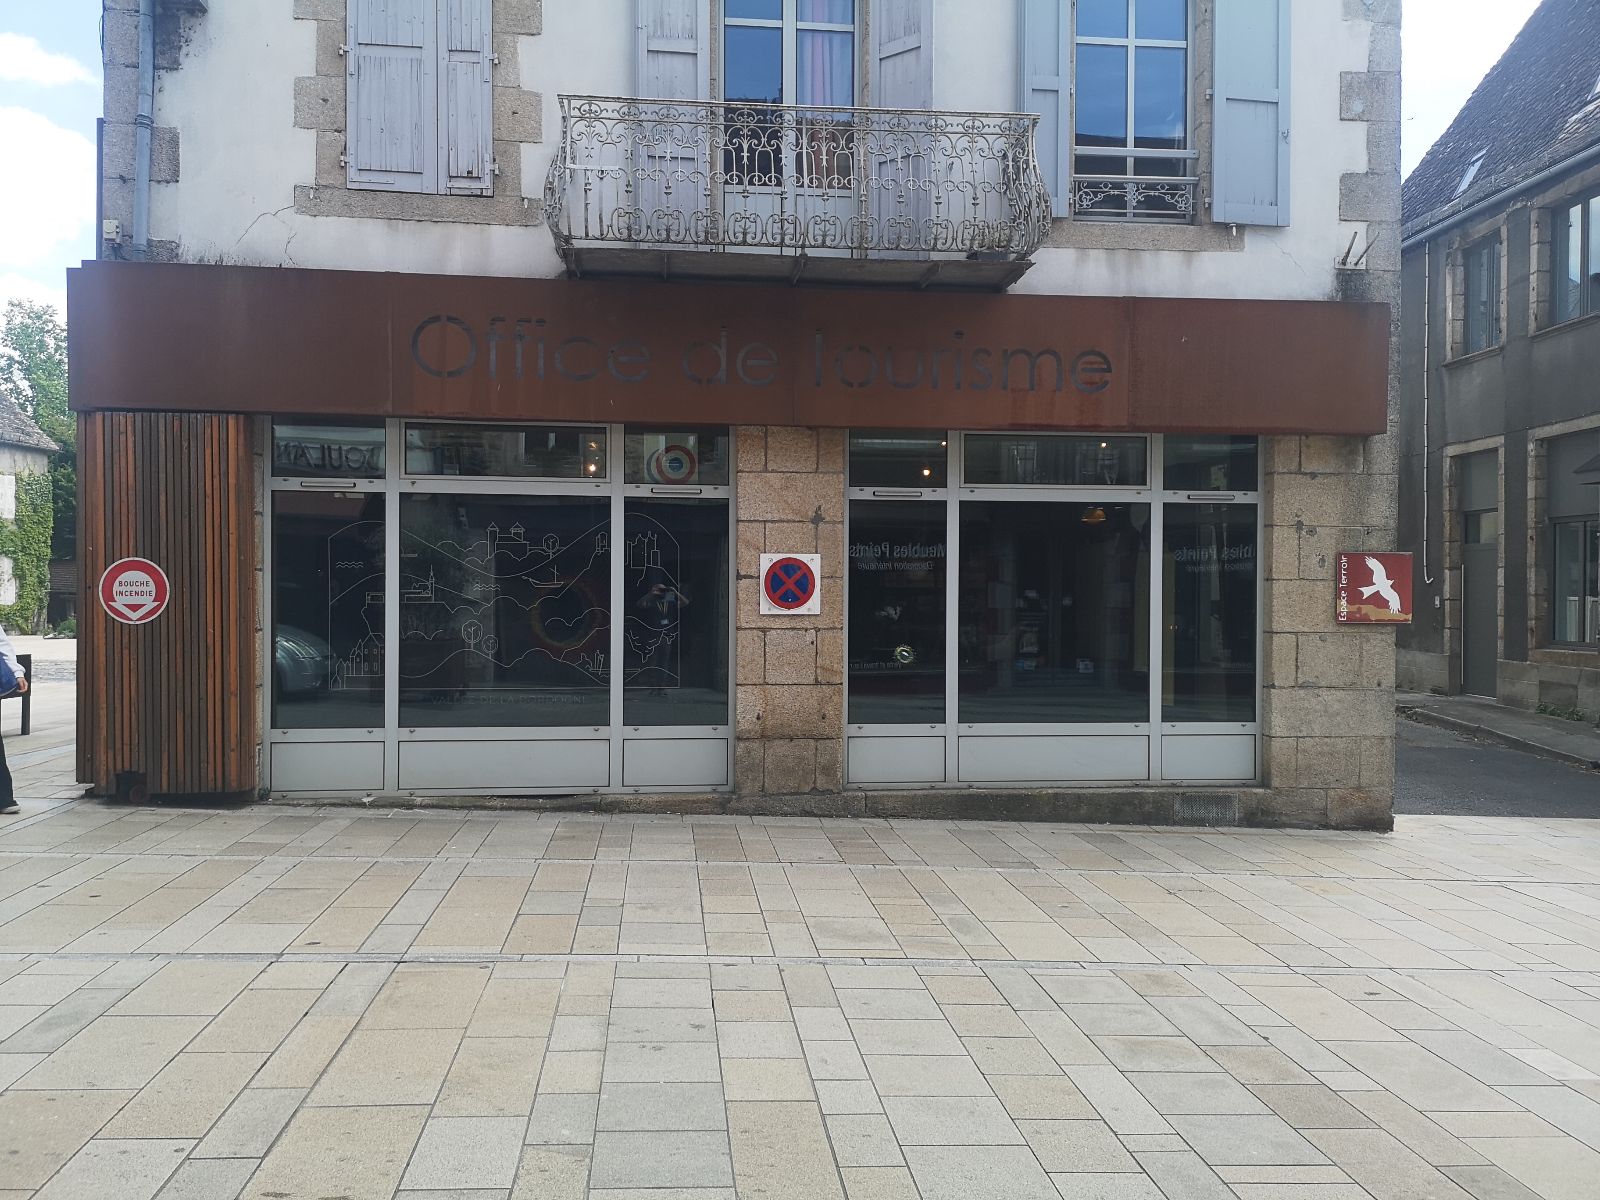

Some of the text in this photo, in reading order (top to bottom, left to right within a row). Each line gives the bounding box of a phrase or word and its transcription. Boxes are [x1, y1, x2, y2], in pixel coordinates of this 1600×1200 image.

[411, 314, 651, 383] Office
[682, 325, 780, 386] de
[118, 580, 150, 588] BOUCHE
[1338, 554, 1348, 621] Espace Terroir
